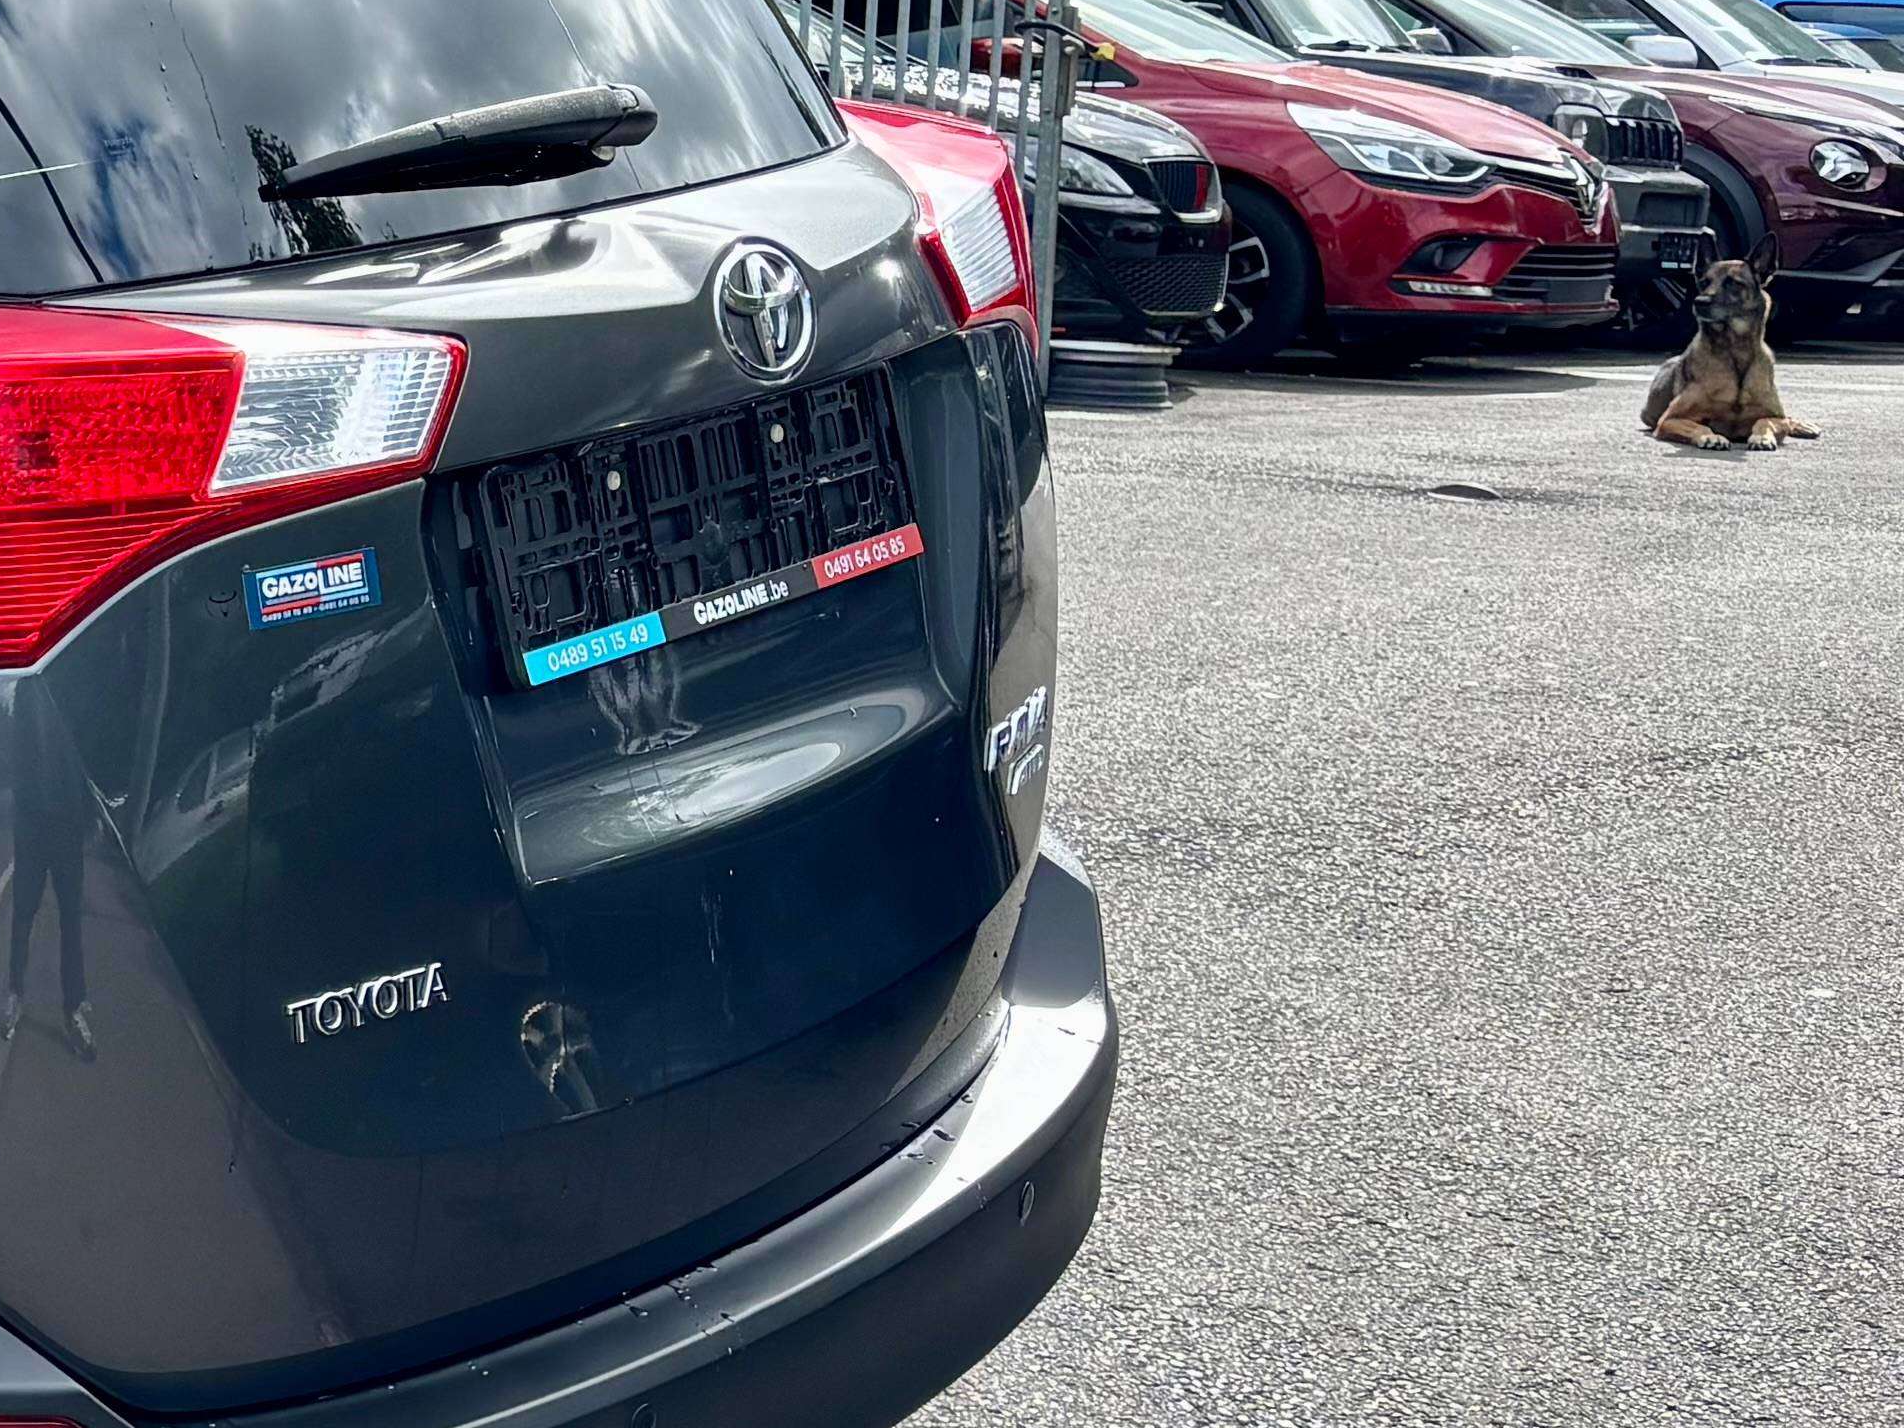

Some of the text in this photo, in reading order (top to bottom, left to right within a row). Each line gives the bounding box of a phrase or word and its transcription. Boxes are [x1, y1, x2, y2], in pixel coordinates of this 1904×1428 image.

[261, 562, 363, 598] GAZOLINE
[824, 535, 906, 579] 0491 64 05 85
[547, 623, 649, 672] 0489 51 15 49
[286, 961, 449, 1044] TOYOTA
